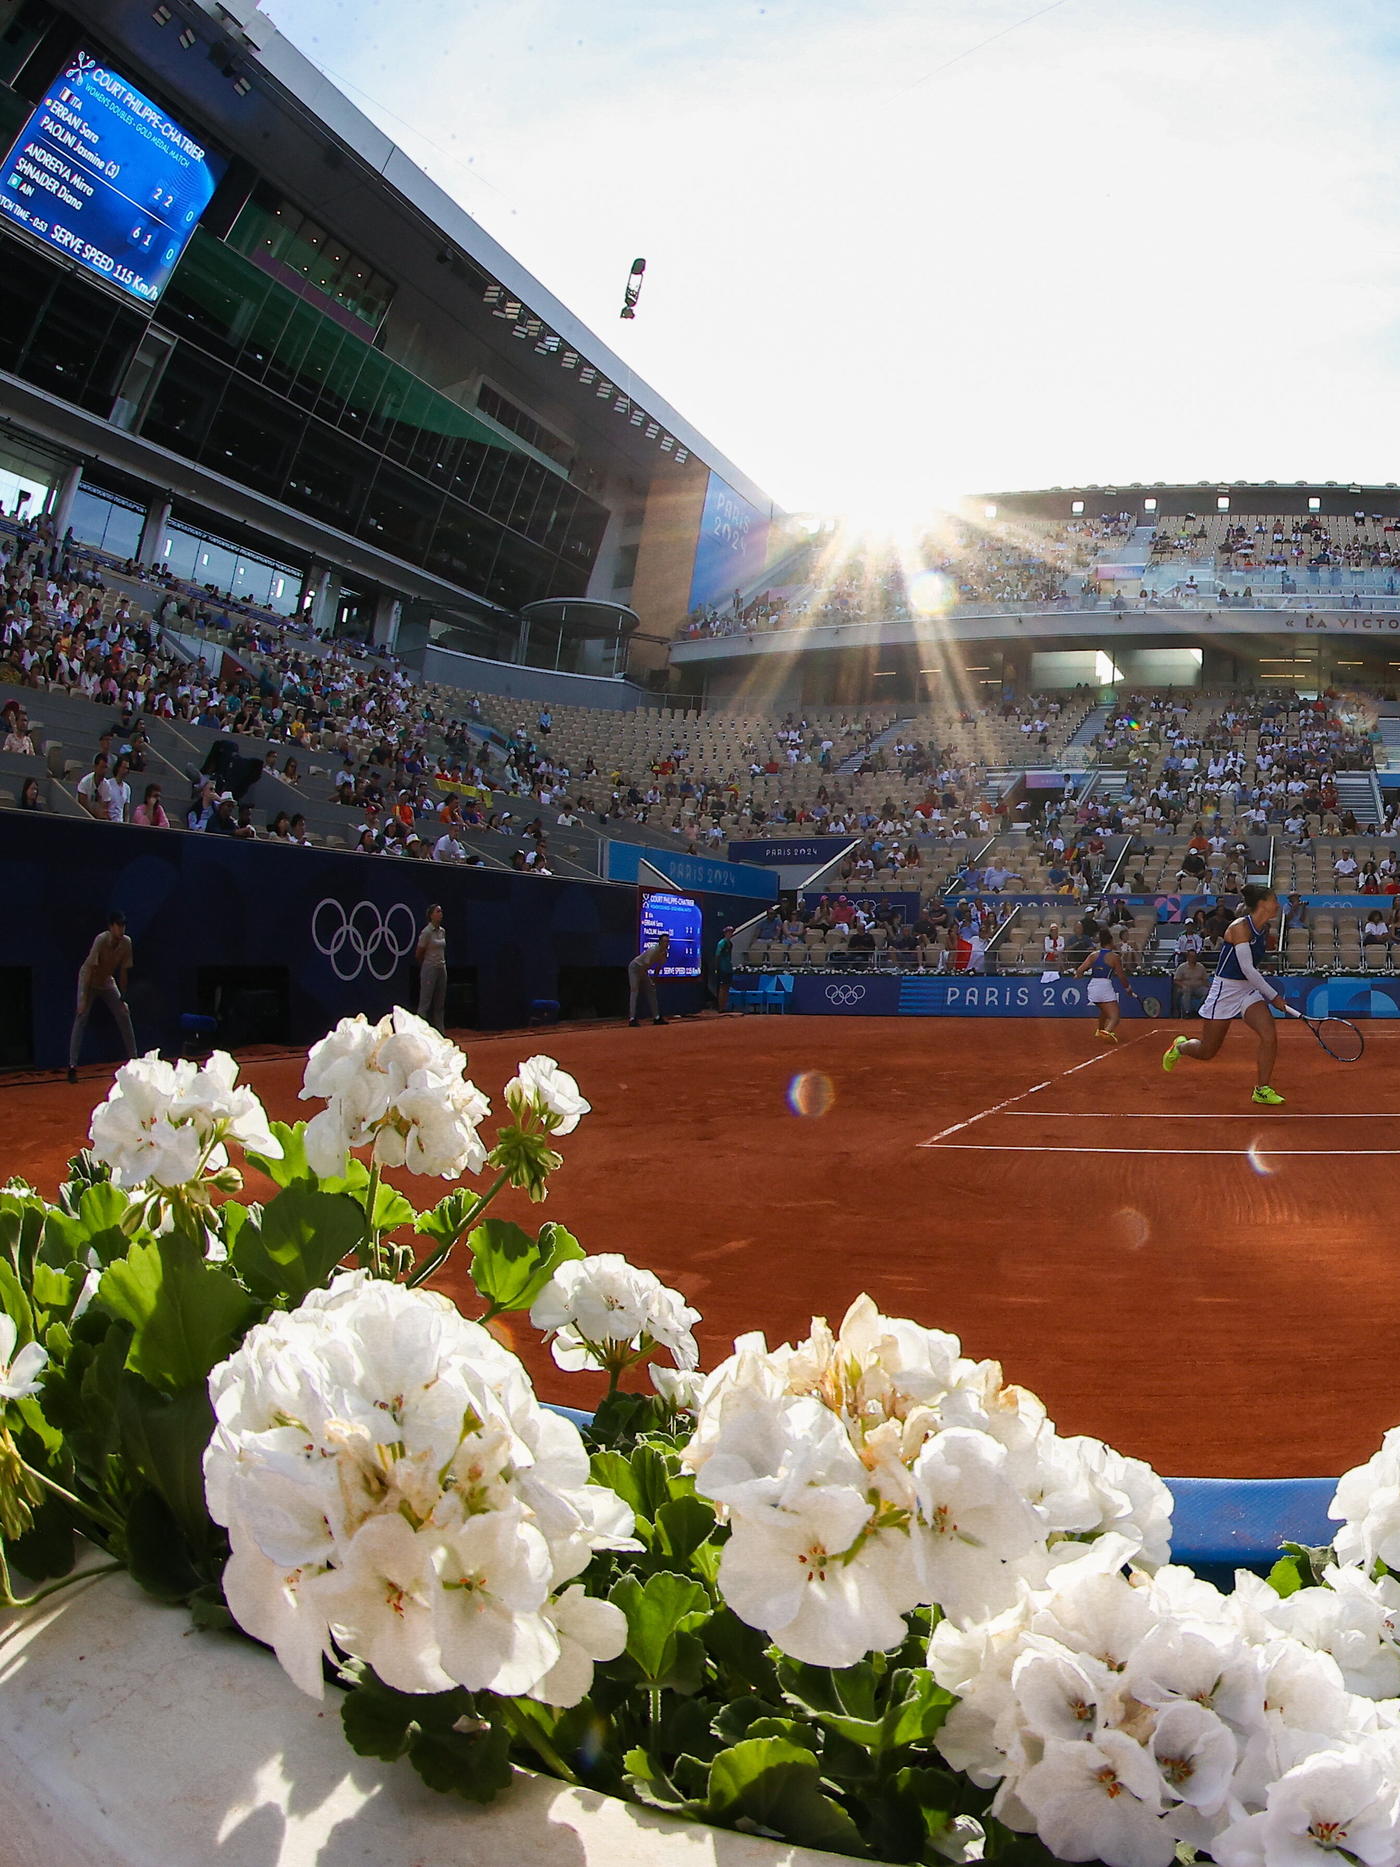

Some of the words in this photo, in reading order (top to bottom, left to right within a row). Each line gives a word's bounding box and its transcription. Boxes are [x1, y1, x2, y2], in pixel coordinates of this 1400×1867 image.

[69, 95, 83, 111] ITA
[93, 68, 127, 100] COURT
[122, 91, 205, 162] PHILIPPE-CHATRIER
[49, 100, 82, 130] ERRANI
[79, 122, 99, 144] Sara
[108, 100, 134, 126] DOUBLES
[135, 123, 153, 140] GOLD
[152, 136, 169, 154] MEDAL
[168, 149, 190, 168] MATCH
[39, 115, 77, 148] PAOLINI
[73, 140, 105, 170] Jasmine
[105, 160, 120, 179] (3)
[15, 157, 60, 194] SHNAIDER
[57, 185, 83, 211] Diana
[24, 143, 72, 181] ANDREEVA
[69, 173, 95, 197] Mirra
[18, 183, 35, 197] AIN
[153, 188, 163, 200] 2
[163, 195, 174, 208] 2
[185, 210, 194, 222] 0
[0, 194, 16, 211] TCH
[14, 204, 31, 221] TIME
[133, 226, 141, 239] 6
[144, 234, 152, 247] 1
[165, 248, 174, 260] 0
[51, 224, 85, 254] SERVE
[82, 244, 114, 272] SPEED
[113, 264, 134, 284] 115
[132, 275, 158, 301] Km/h
[1305, 617, 1328, 629] LA
[794, 848, 818, 856] 2024
[707, 869, 736, 886] 2024
